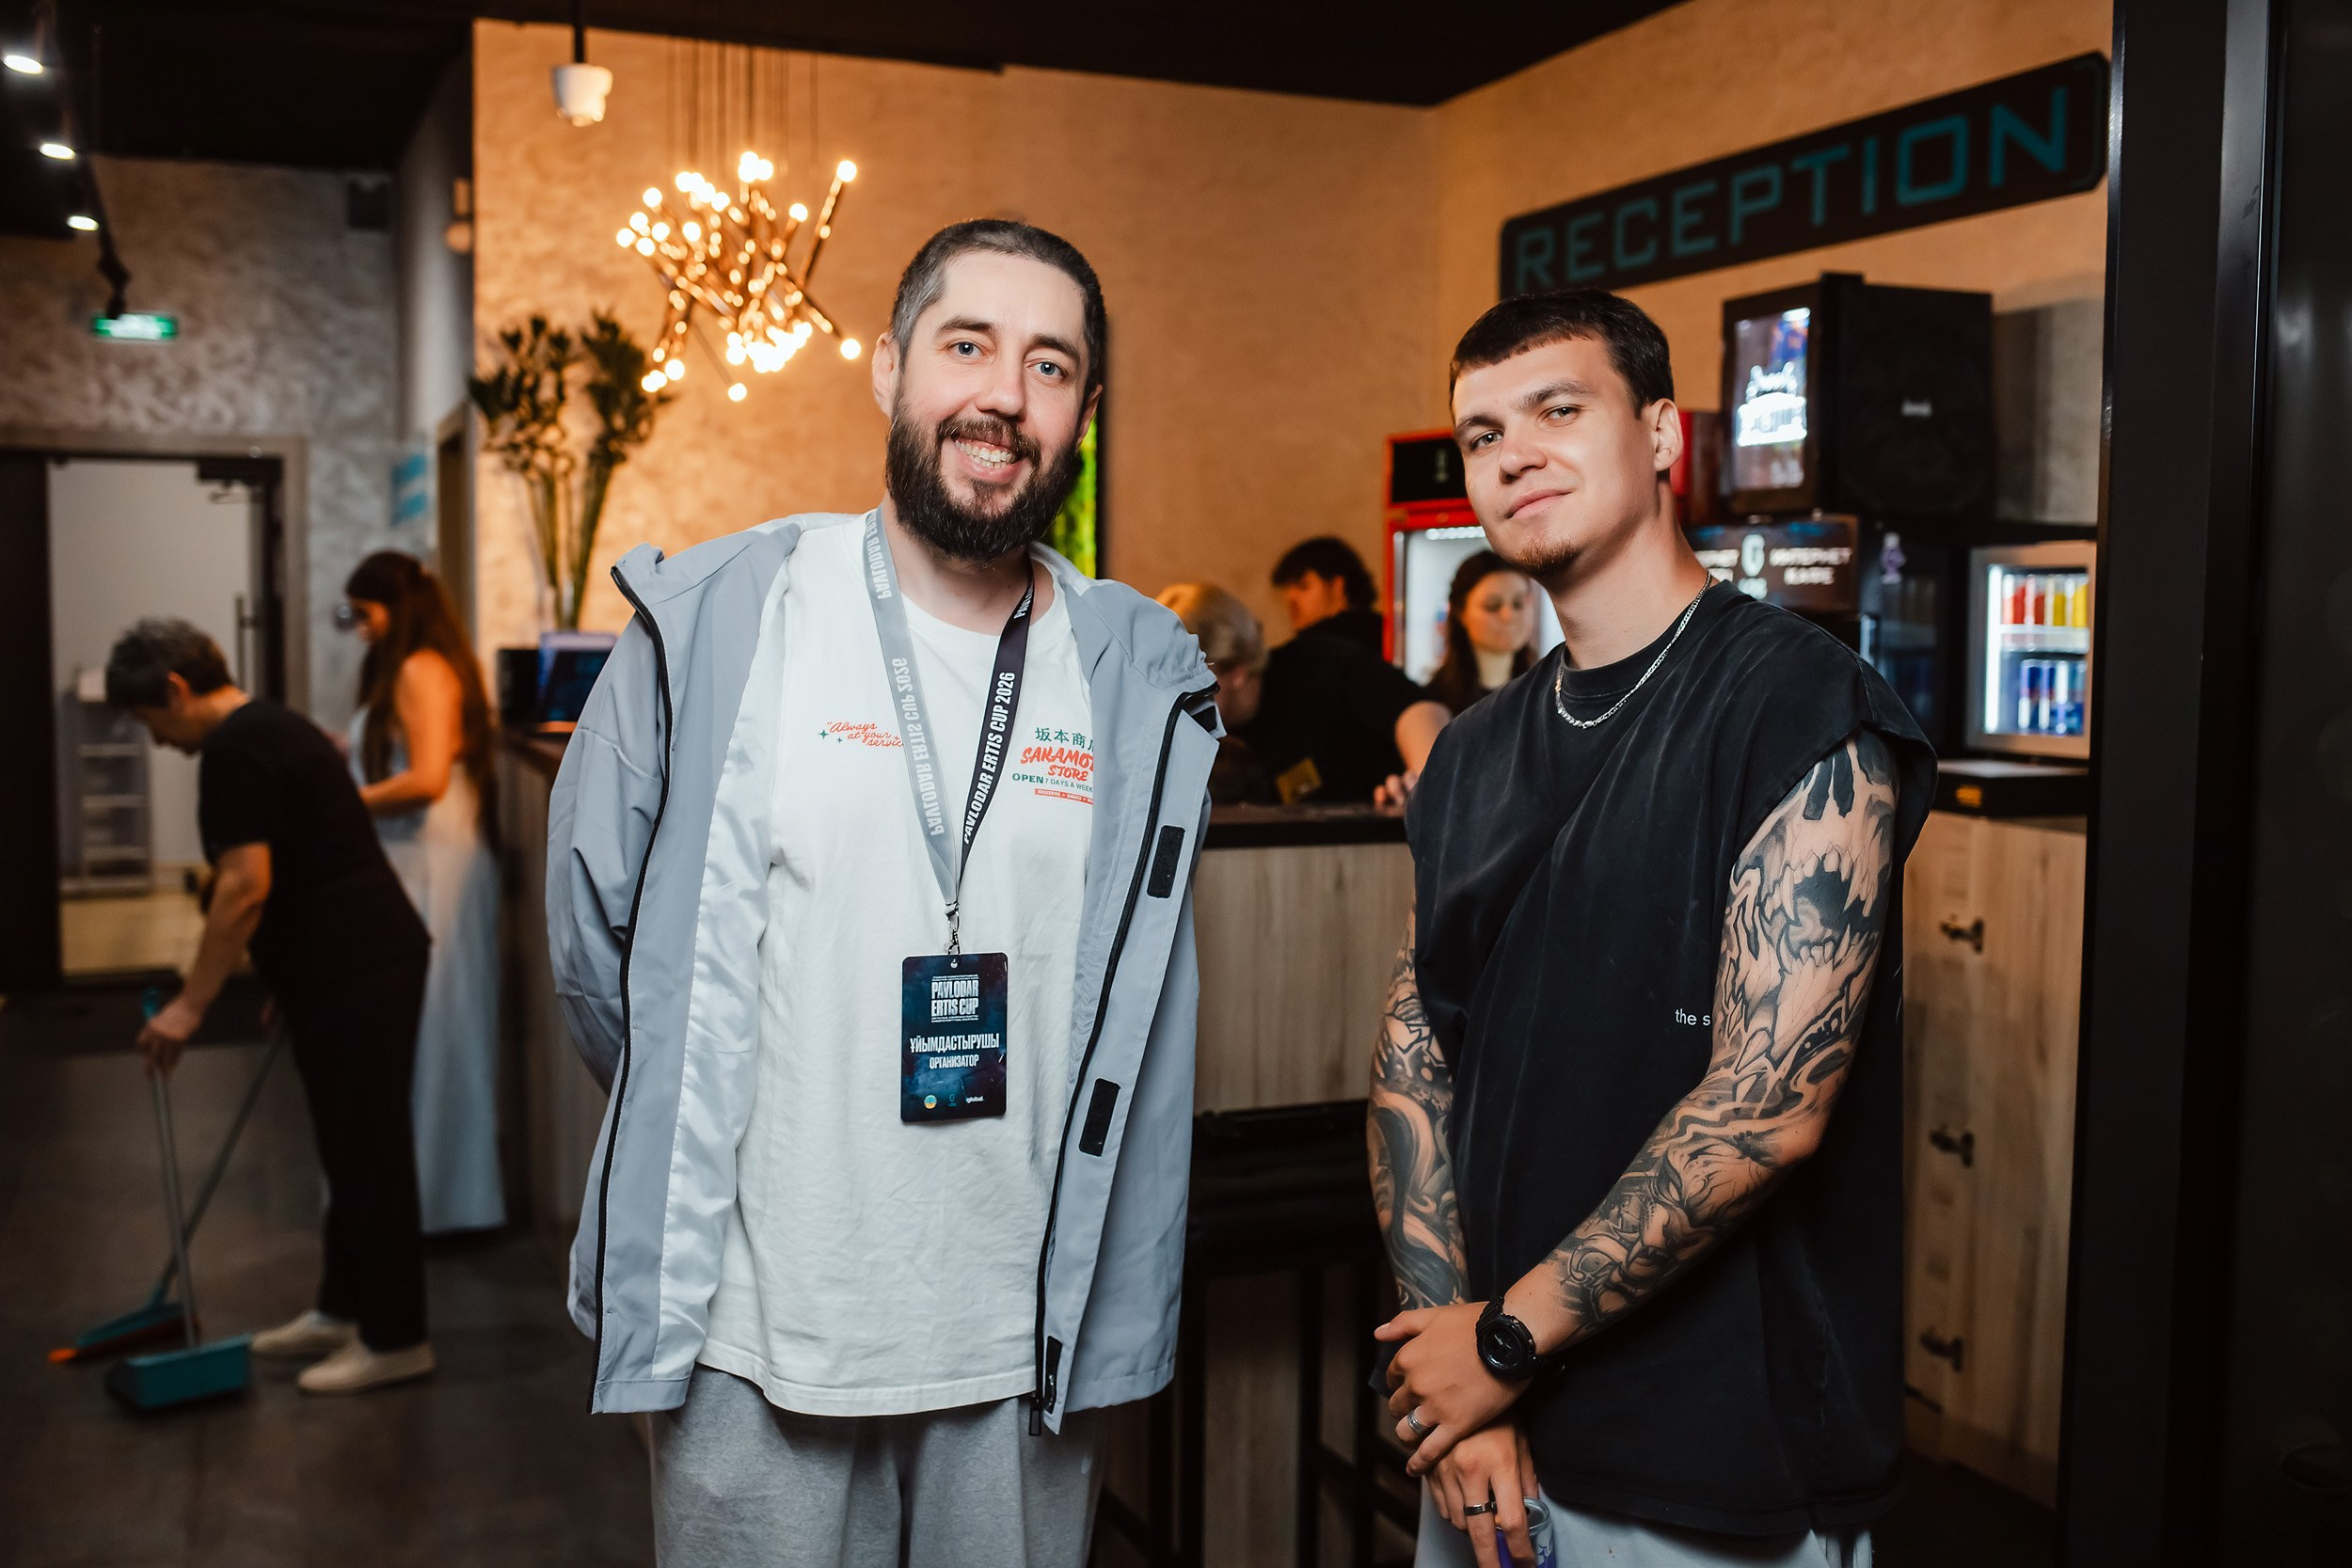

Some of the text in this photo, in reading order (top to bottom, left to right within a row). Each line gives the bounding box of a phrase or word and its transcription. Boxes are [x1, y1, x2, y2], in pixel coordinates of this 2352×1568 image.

[1514, 86, 2068, 291] RECEPTION
[862, 731, 892, 743] your
[1035, 727, 1094, 752] 坂本商
[963, 672, 1016, 846] PAVLODAR ERTIS CUP 2026
[1012, 773, 1044, 784] OPEN
[1050, 779, 1070, 787] DAYS
[1048, 764, 1089, 782] STORE
[930, 979, 979, 999] PAVLODAR
[930, 997, 978, 1017] ERTIS CUP
[1675, 1008, 1697, 1025] the
[910, 1033, 1000, 1053] ҰЙЫМДАСТЫРУШЫ
[929, 1054, 979, 1069] ОРГАНИЗАТОР
